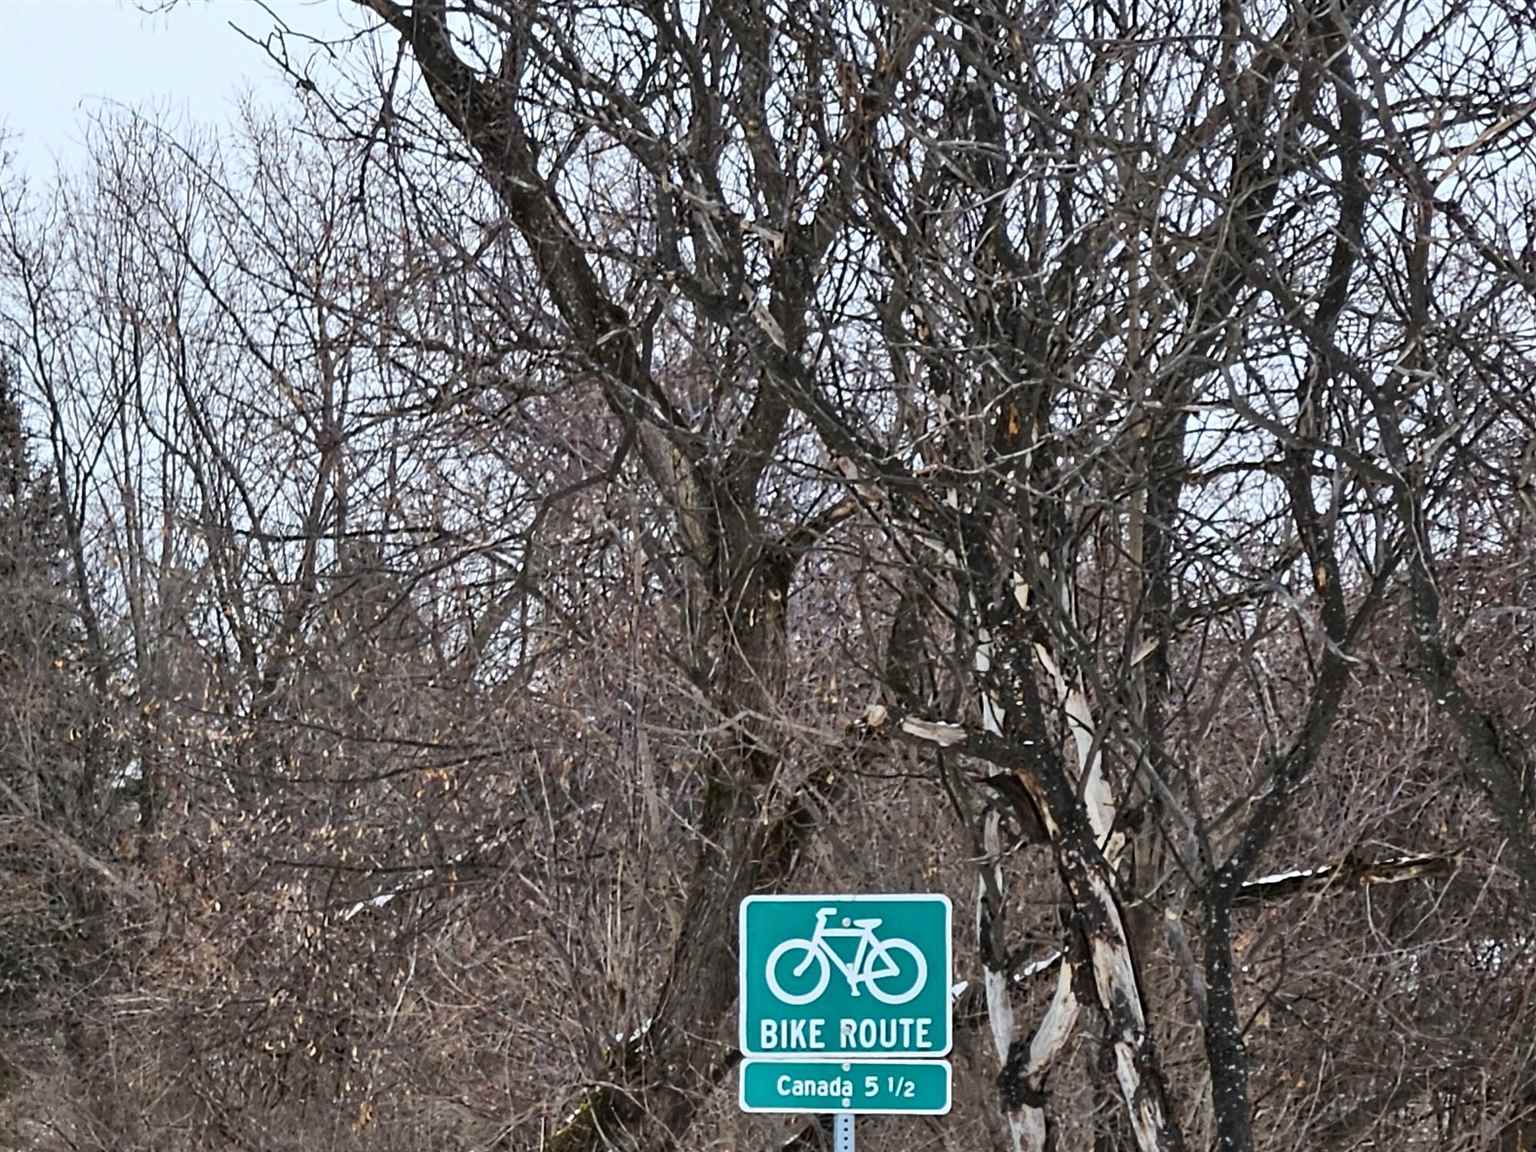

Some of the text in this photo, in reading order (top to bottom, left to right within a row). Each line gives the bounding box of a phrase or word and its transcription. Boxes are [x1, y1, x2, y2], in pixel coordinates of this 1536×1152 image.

[760, 1017, 932, 1048] BIKE ROUTE
[776, 1075, 915, 1098] Canada 5 1/2
